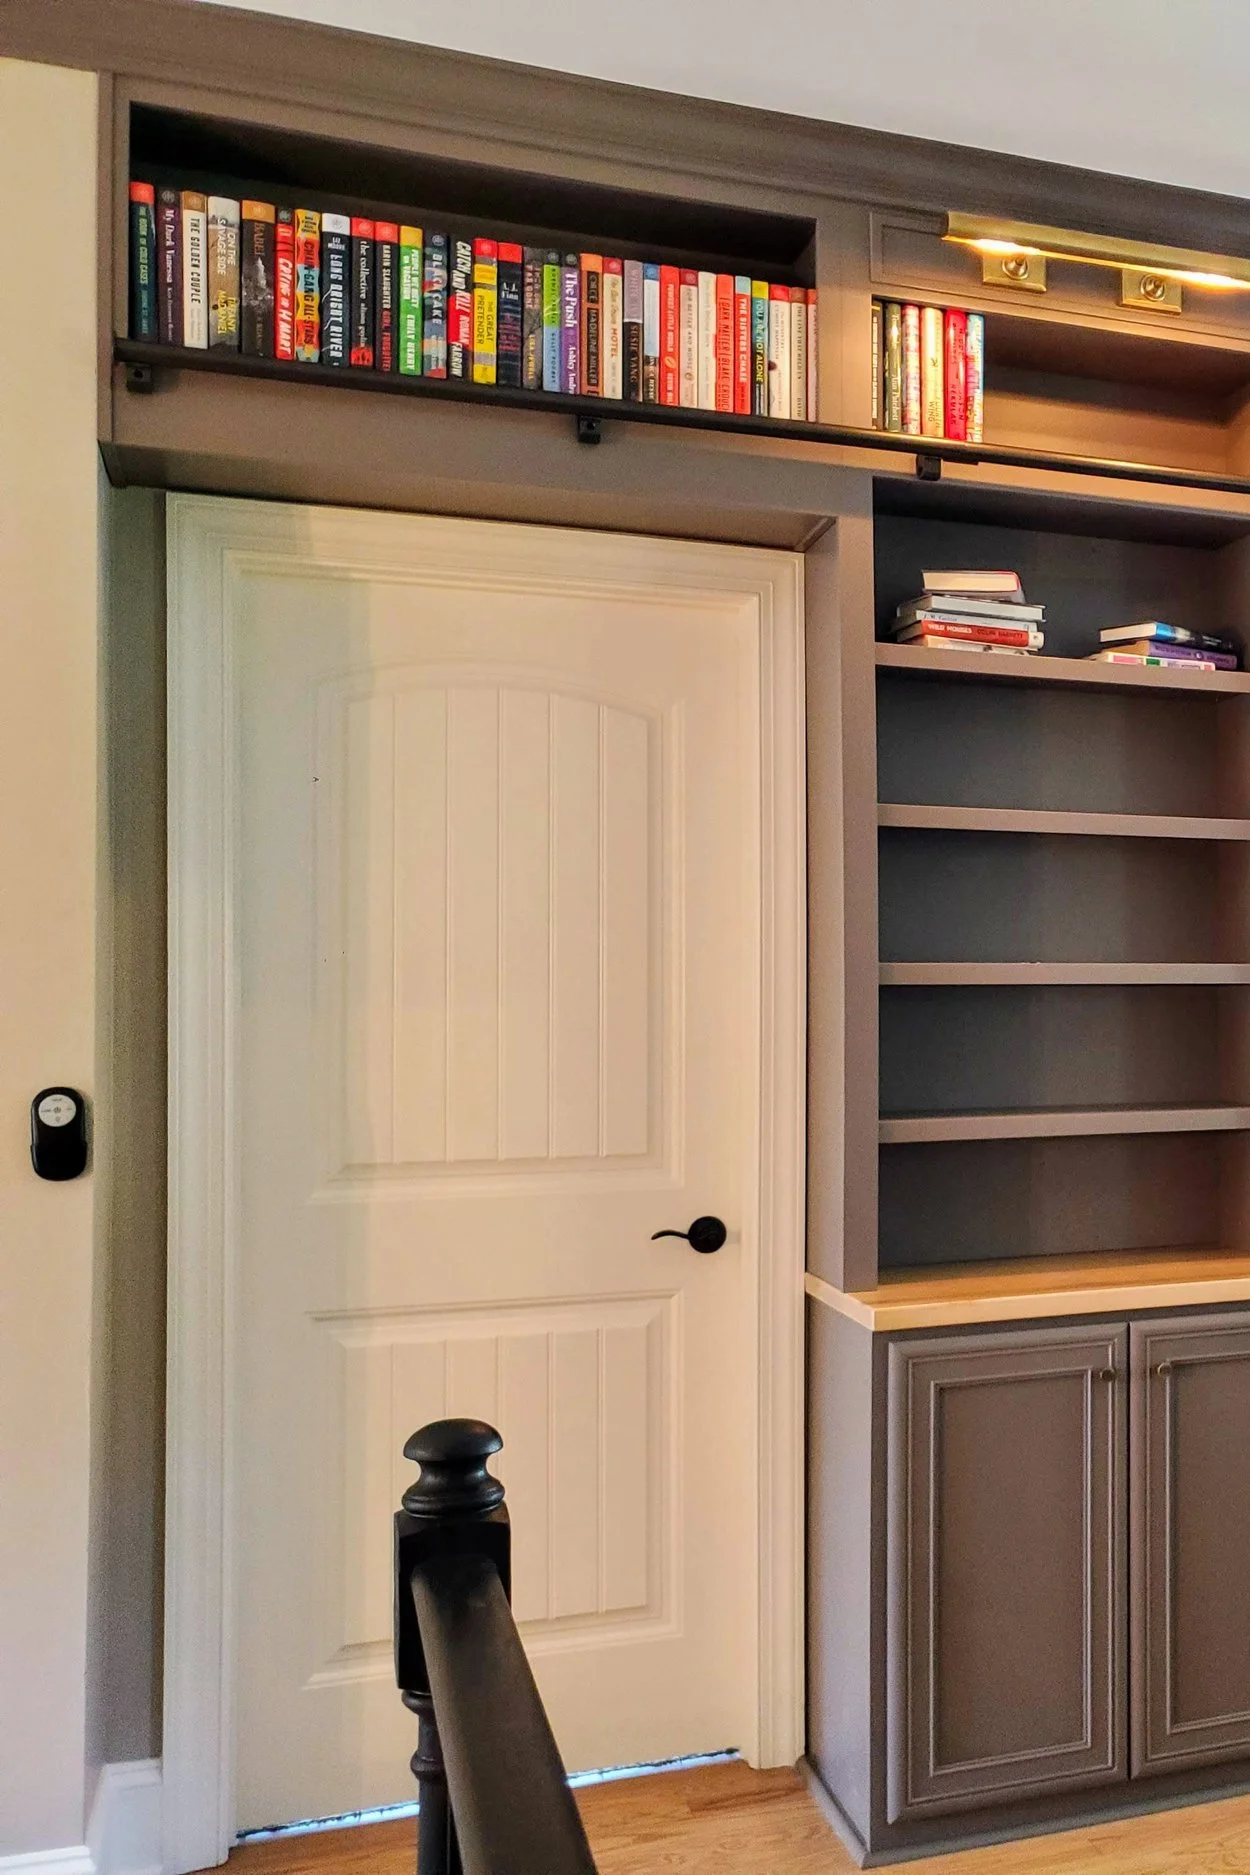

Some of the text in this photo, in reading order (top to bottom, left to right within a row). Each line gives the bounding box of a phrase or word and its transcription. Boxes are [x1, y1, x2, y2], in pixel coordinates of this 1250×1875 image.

[190, 218, 200, 232] THE
[253, 223, 265, 256] BABEL
[163, 208, 175, 283] My Dark Vanessa
[190, 237, 201, 268] GOLDEN
[216, 219, 226, 275] SAVAGE SIDE
[226, 232, 235, 265] ON THE
[411, 249, 419, 276] PEOPLE
[140, 265, 148, 284] CASES
[278, 258, 292, 295] CRYING
[303, 241, 315, 302] CHAIN-GANG
[359, 241, 368, 299] the collective
[382, 245, 391, 309] KARIN SLAUGHTER
[403, 266, 411, 300] VACATION
[432, 253, 442, 290] BLACK
[452, 241, 471, 313] CATCH AND KILL
[191, 272, 201, 304] COUPLE
[411, 289, 419, 308] MEET
[502, 290, 518, 300] Finn
[566, 272, 577, 327] The Push
[589, 275, 597, 302] CIRCE
[280, 309, 291, 320] H
[330, 254, 343, 357] LONG BRIGHT RIVER
[432, 293, 442, 325] CAKE
[477, 295, 485, 345] PRETENDER
[755, 299, 763, 317] YOU
[280, 321, 292, 357] MART
[303, 304, 316, 345] ALL-STARS
[721, 302, 730, 350] DARK MATTER
[739, 317, 747, 351] SISTERS
[755, 318, 764, 334] ARE
[406, 314, 416, 370] EMILY HENRY
[450, 315, 469, 377] RONAN FARROW
[567, 345, 576, 369] Ashley
[589, 310, 598, 384] MADELINE MILLER
[630, 325, 639, 383] SUSIE YANG
[756, 336, 764, 354] NOT
[721, 358, 730, 381] BLAKE
[756, 356, 764, 383] ALONE
[946, 626, 972, 634] HOUSES
